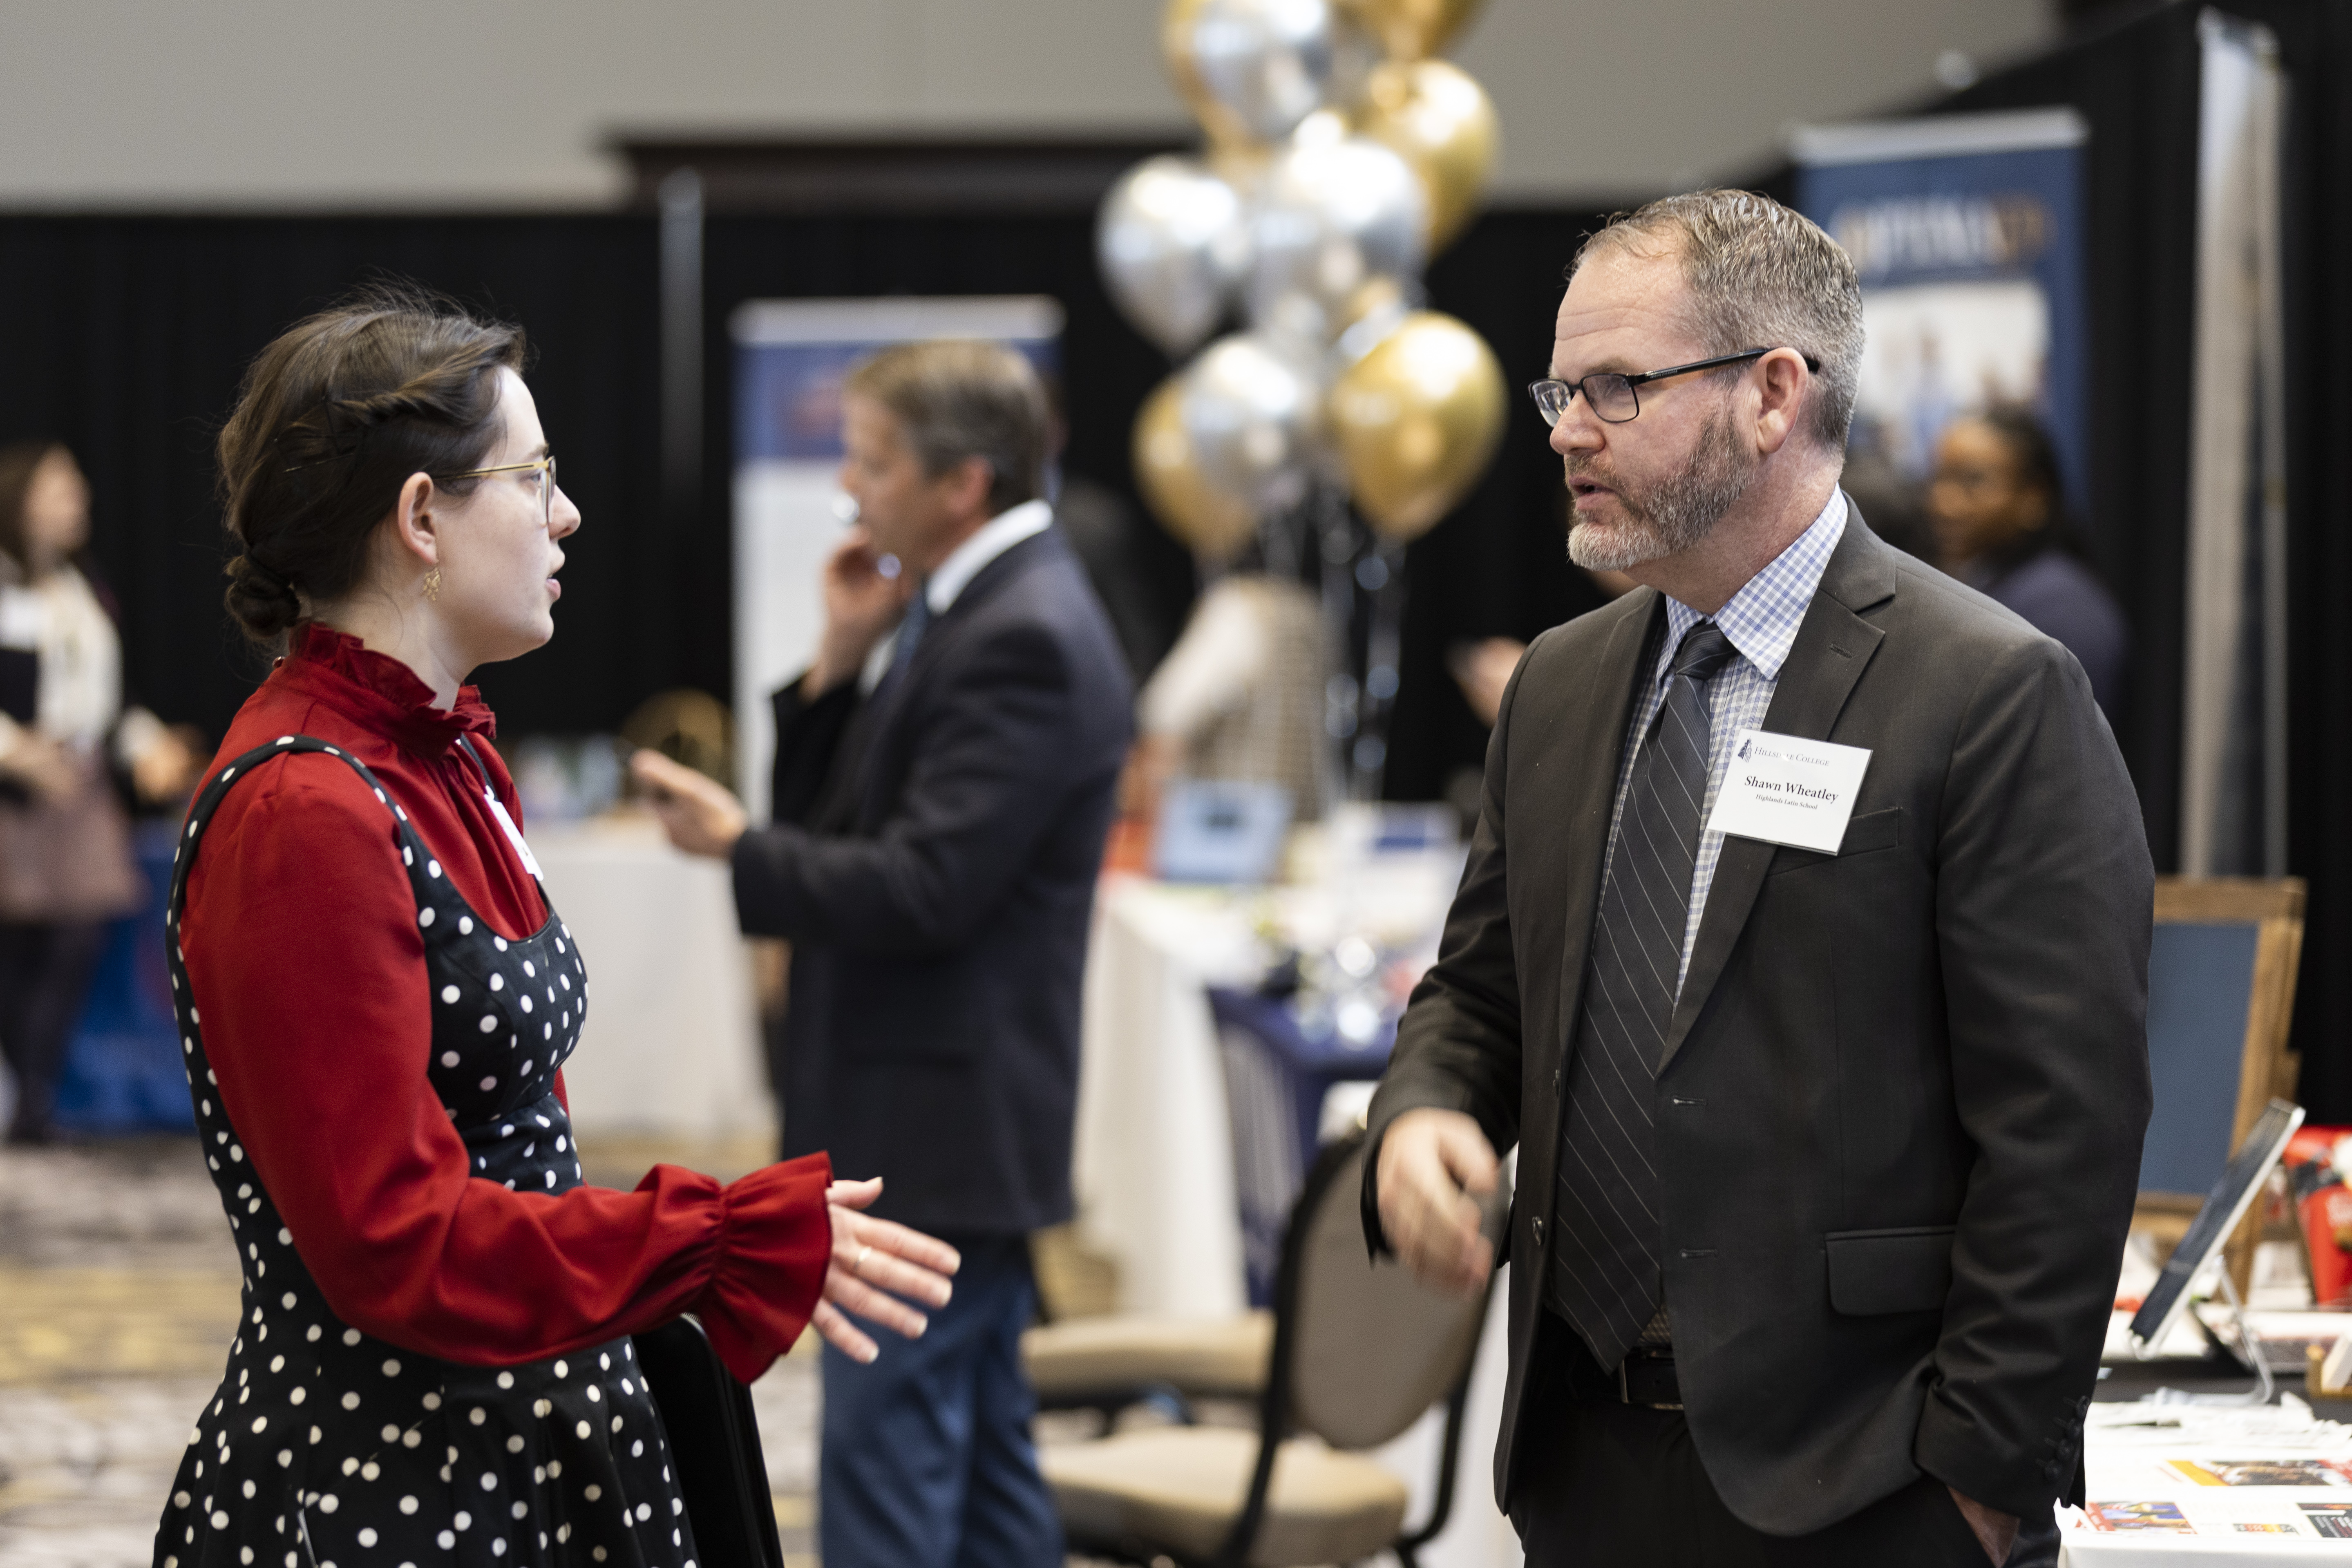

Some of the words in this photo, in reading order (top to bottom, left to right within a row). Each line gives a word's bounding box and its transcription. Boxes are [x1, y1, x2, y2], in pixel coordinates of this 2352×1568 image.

[1755, 747, 1794, 760] HILLSDLE
[1796, 754, 1829, 766] COLLEGE
[1744, 776, 1781, 791] Shawn
[1786, 782, 1838, 804] Wheatley
[1755, 794, 1783, 803] Highlands
[1799, 801, 1818, 810] School
